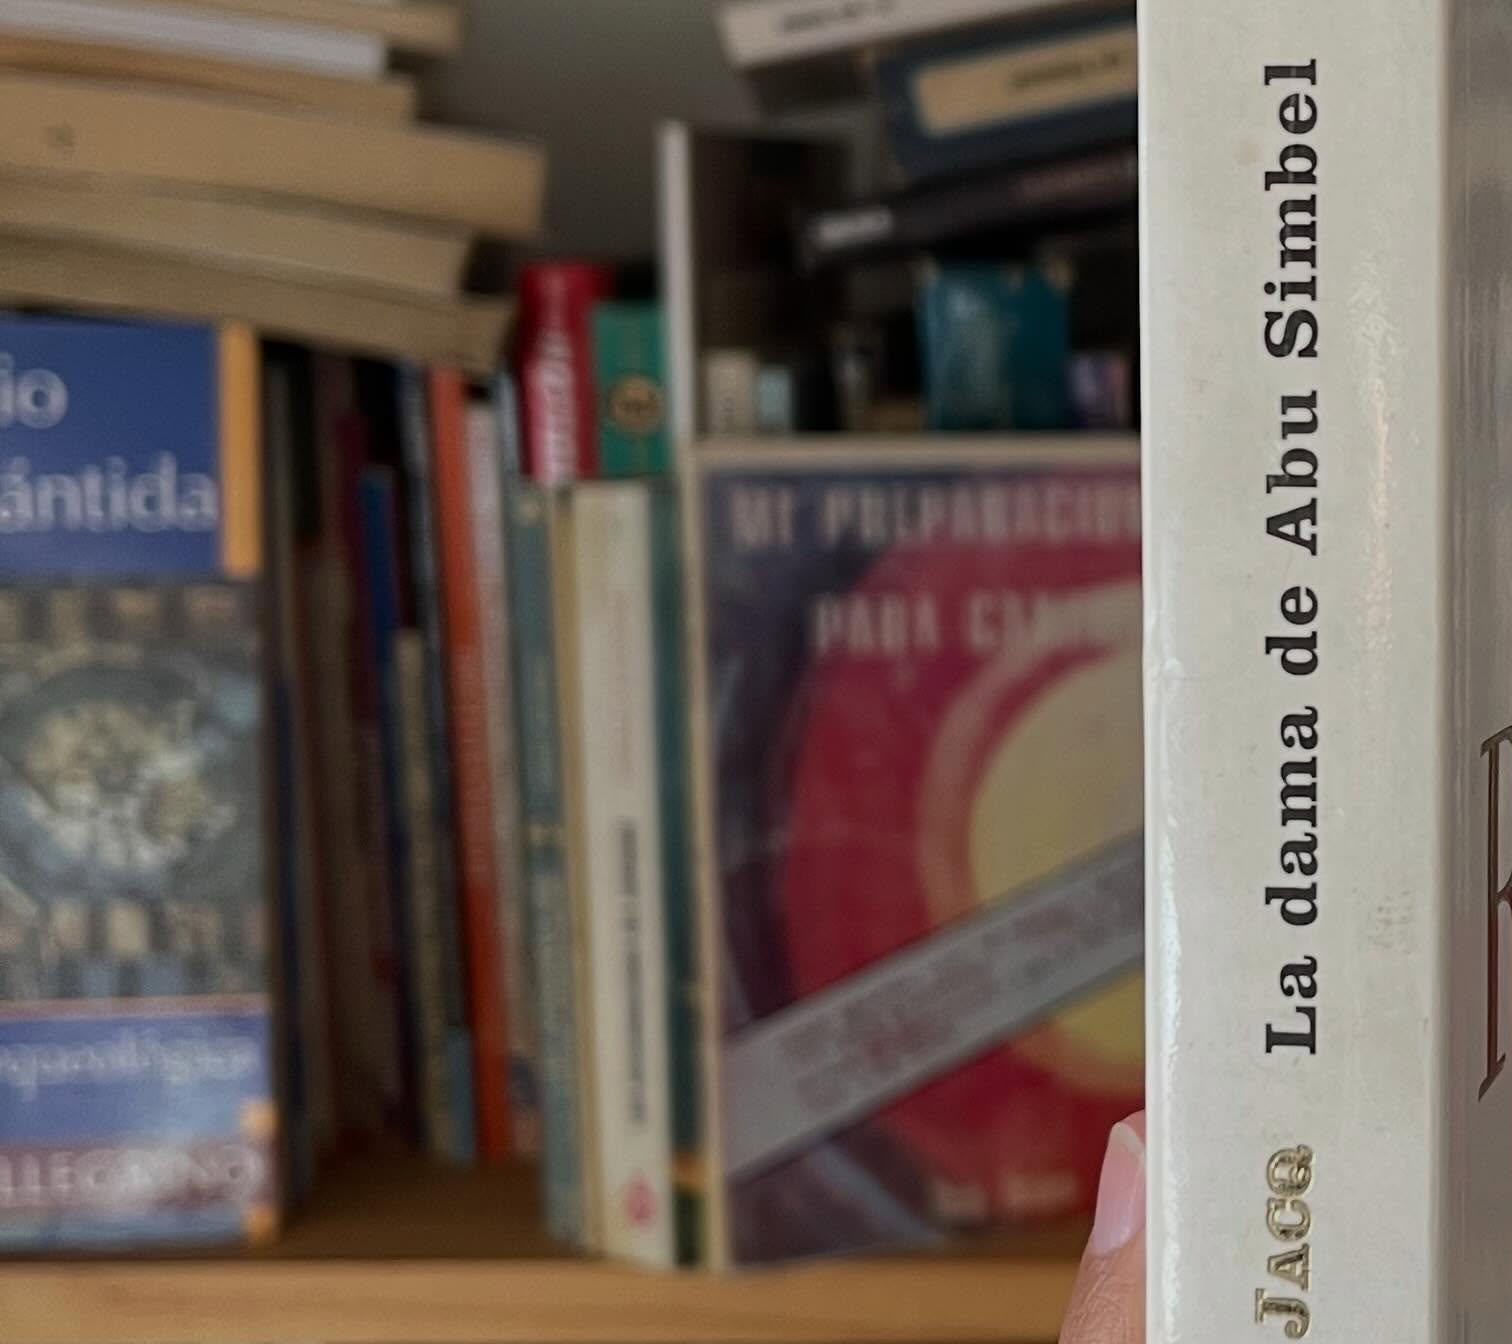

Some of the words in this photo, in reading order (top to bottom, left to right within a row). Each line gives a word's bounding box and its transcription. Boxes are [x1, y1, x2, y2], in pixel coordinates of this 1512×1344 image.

[1263, 58, 1319, 359] Simbel
[1264, 389, 1318, 556] Abu
[1264, 585, 1319, 677] de
[1264, 705, 1319, 926] dama
[1264, 953, 1318, 1055] La
[1253, 1143, 1315, 1340] JACQ
